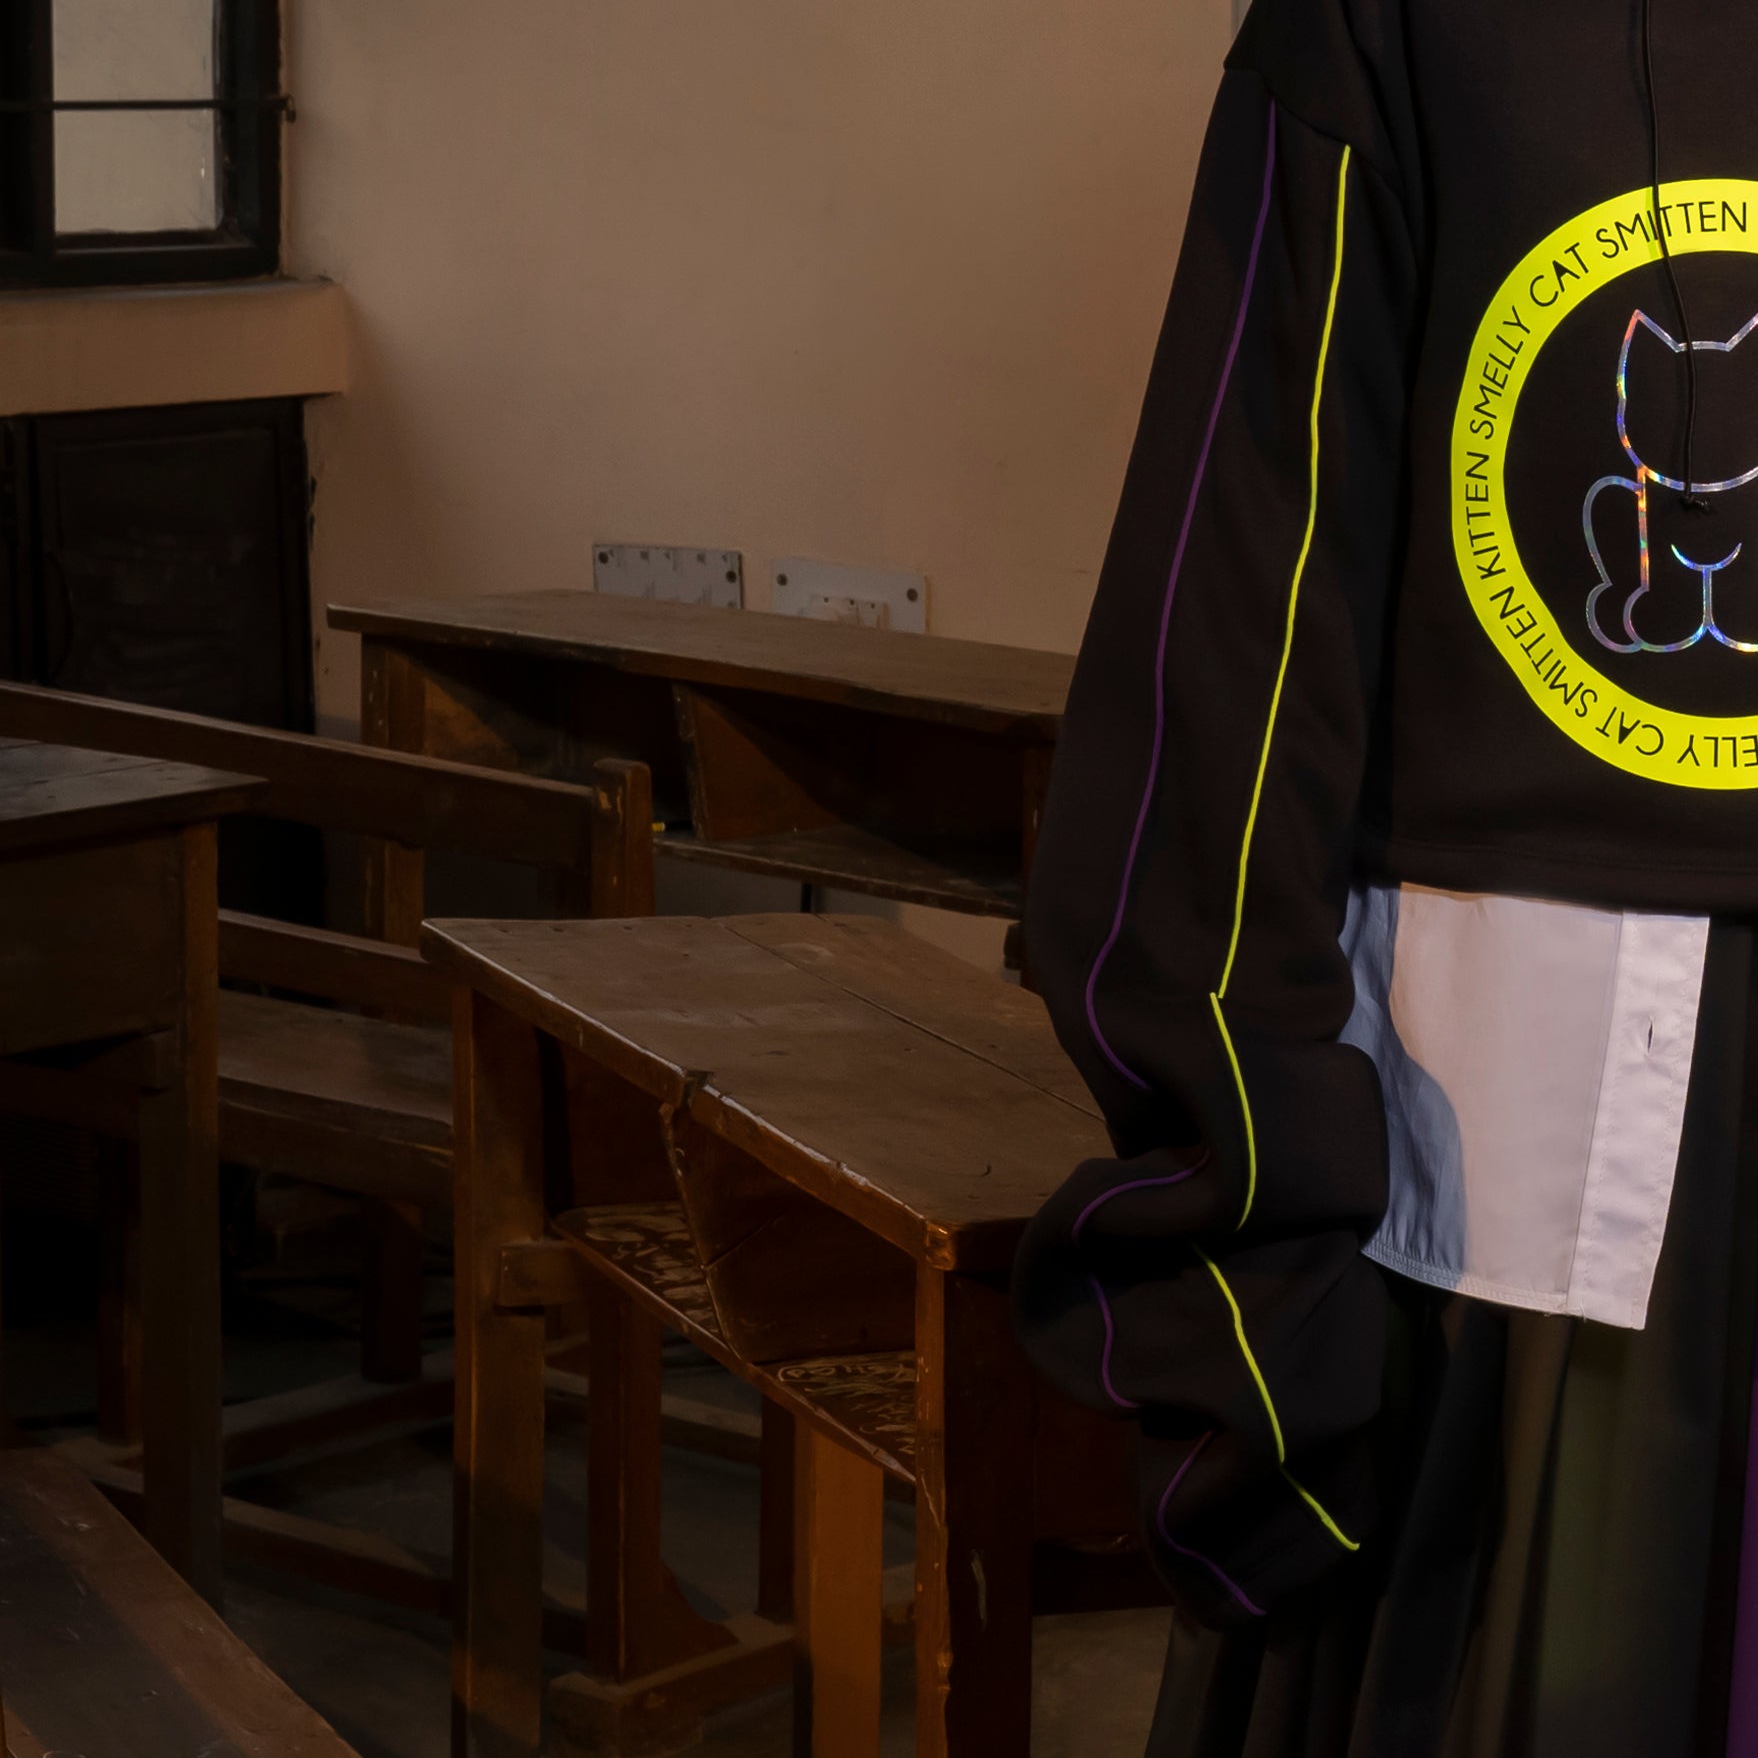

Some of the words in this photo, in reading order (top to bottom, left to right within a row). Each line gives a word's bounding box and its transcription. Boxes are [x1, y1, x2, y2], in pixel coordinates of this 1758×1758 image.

[1529, 242, 1589, 308] CAT
[1595, 201, 1747, 259] SMITTEN
[1469, 305, 1531, 440] SMELLY
[1465, 451, 1507, 580] KITTEN
[1489, 585, 1598, 718] SMITTEN
[1595, 706, 1664, 756] CAT
